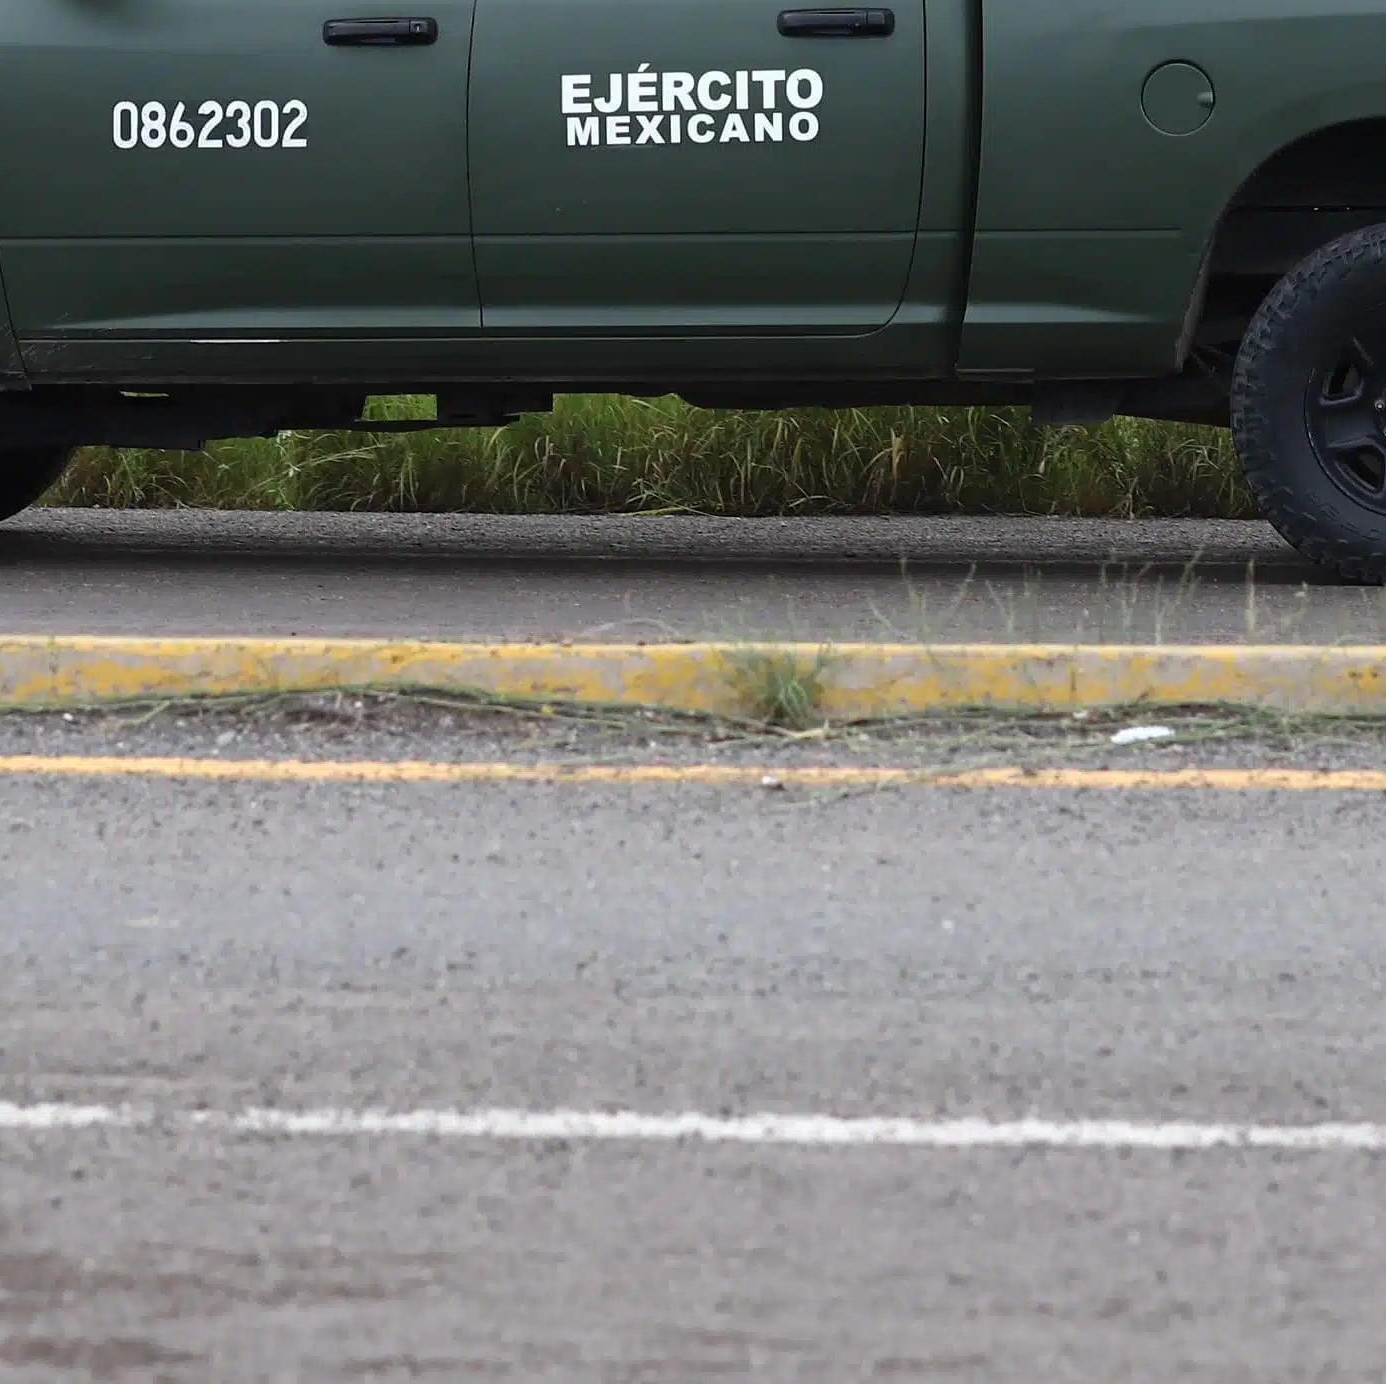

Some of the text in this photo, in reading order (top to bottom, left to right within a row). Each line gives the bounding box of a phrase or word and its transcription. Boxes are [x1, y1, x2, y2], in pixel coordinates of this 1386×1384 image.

[561, 63, 823, 114] EJÉRCITO
[113, 99, 308, 149] 0862302
[566, 111, 819, 146] MEXICANO
